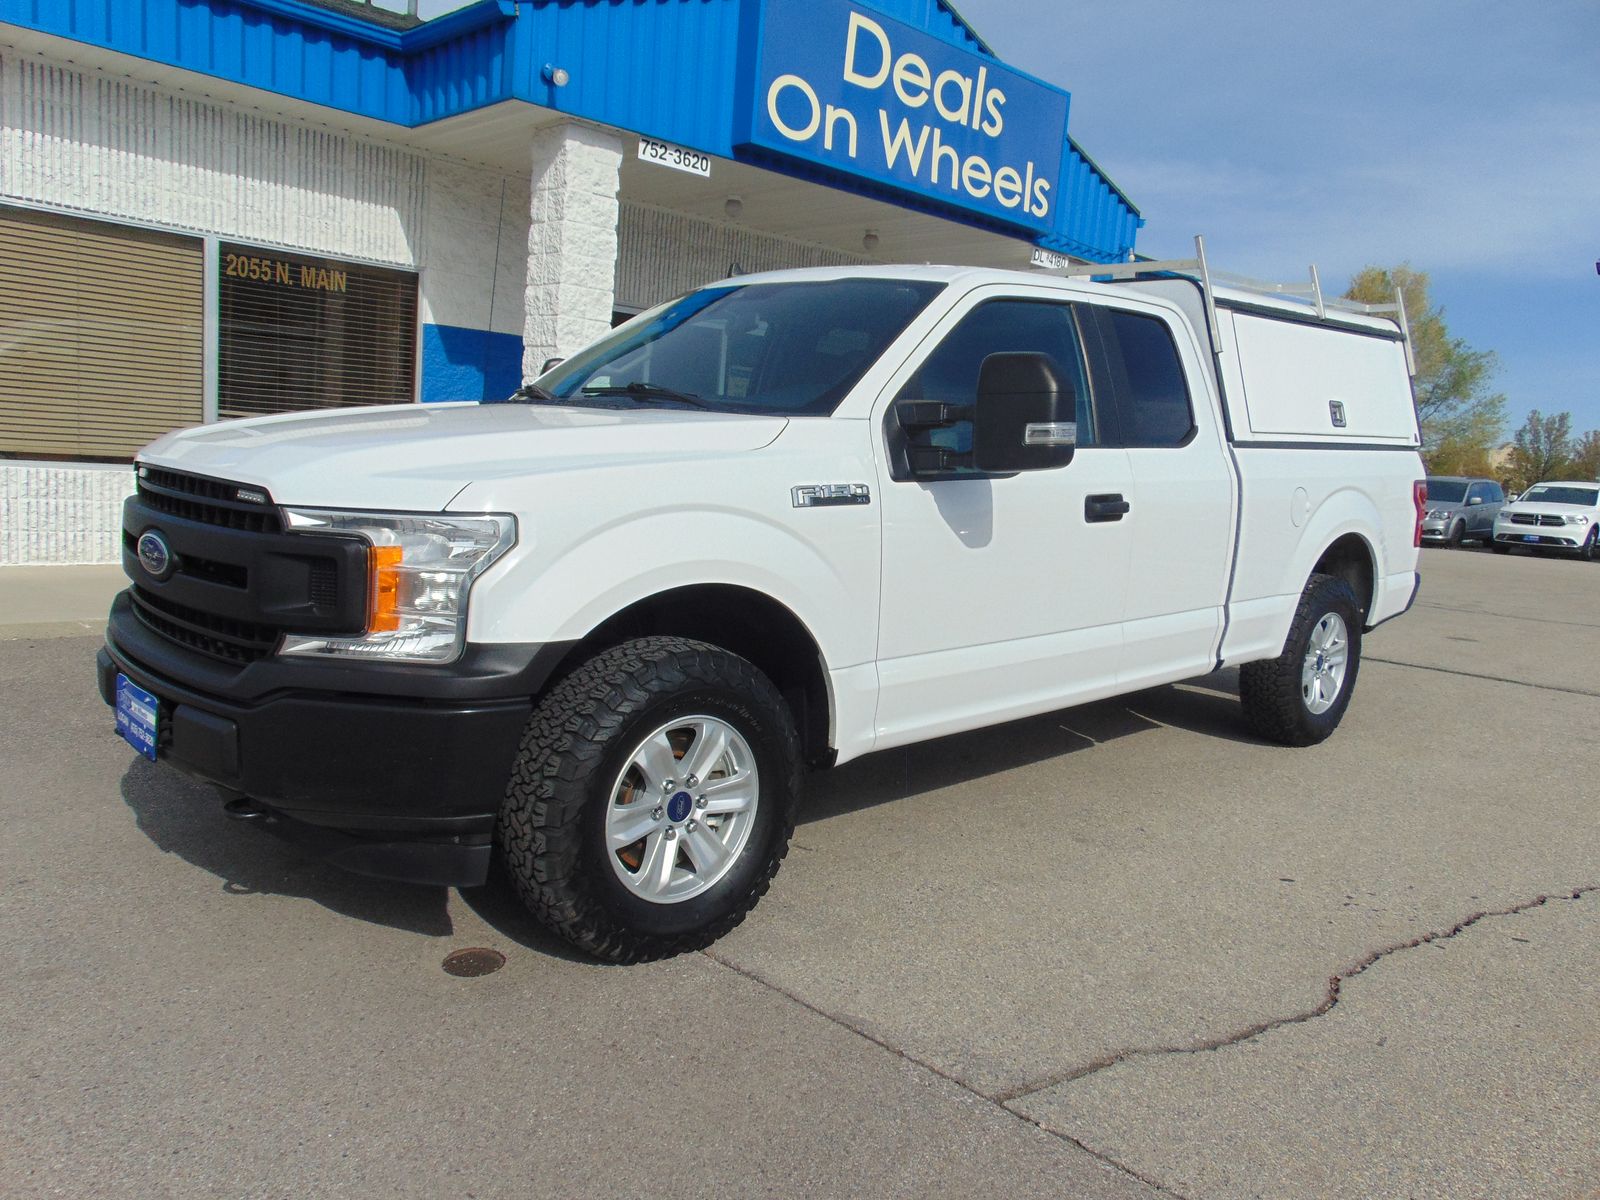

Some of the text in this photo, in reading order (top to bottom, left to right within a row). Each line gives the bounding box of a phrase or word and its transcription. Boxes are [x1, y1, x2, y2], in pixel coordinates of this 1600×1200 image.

[843, 10, 1006, 138] Deals
[641, 138, 709, 172] 752-3620
[767, 74, 1051, 218] On Wheels
[226, 253, 347, 293] 2055 N. MAIN
[1033, 248, 1044, 263] DL
